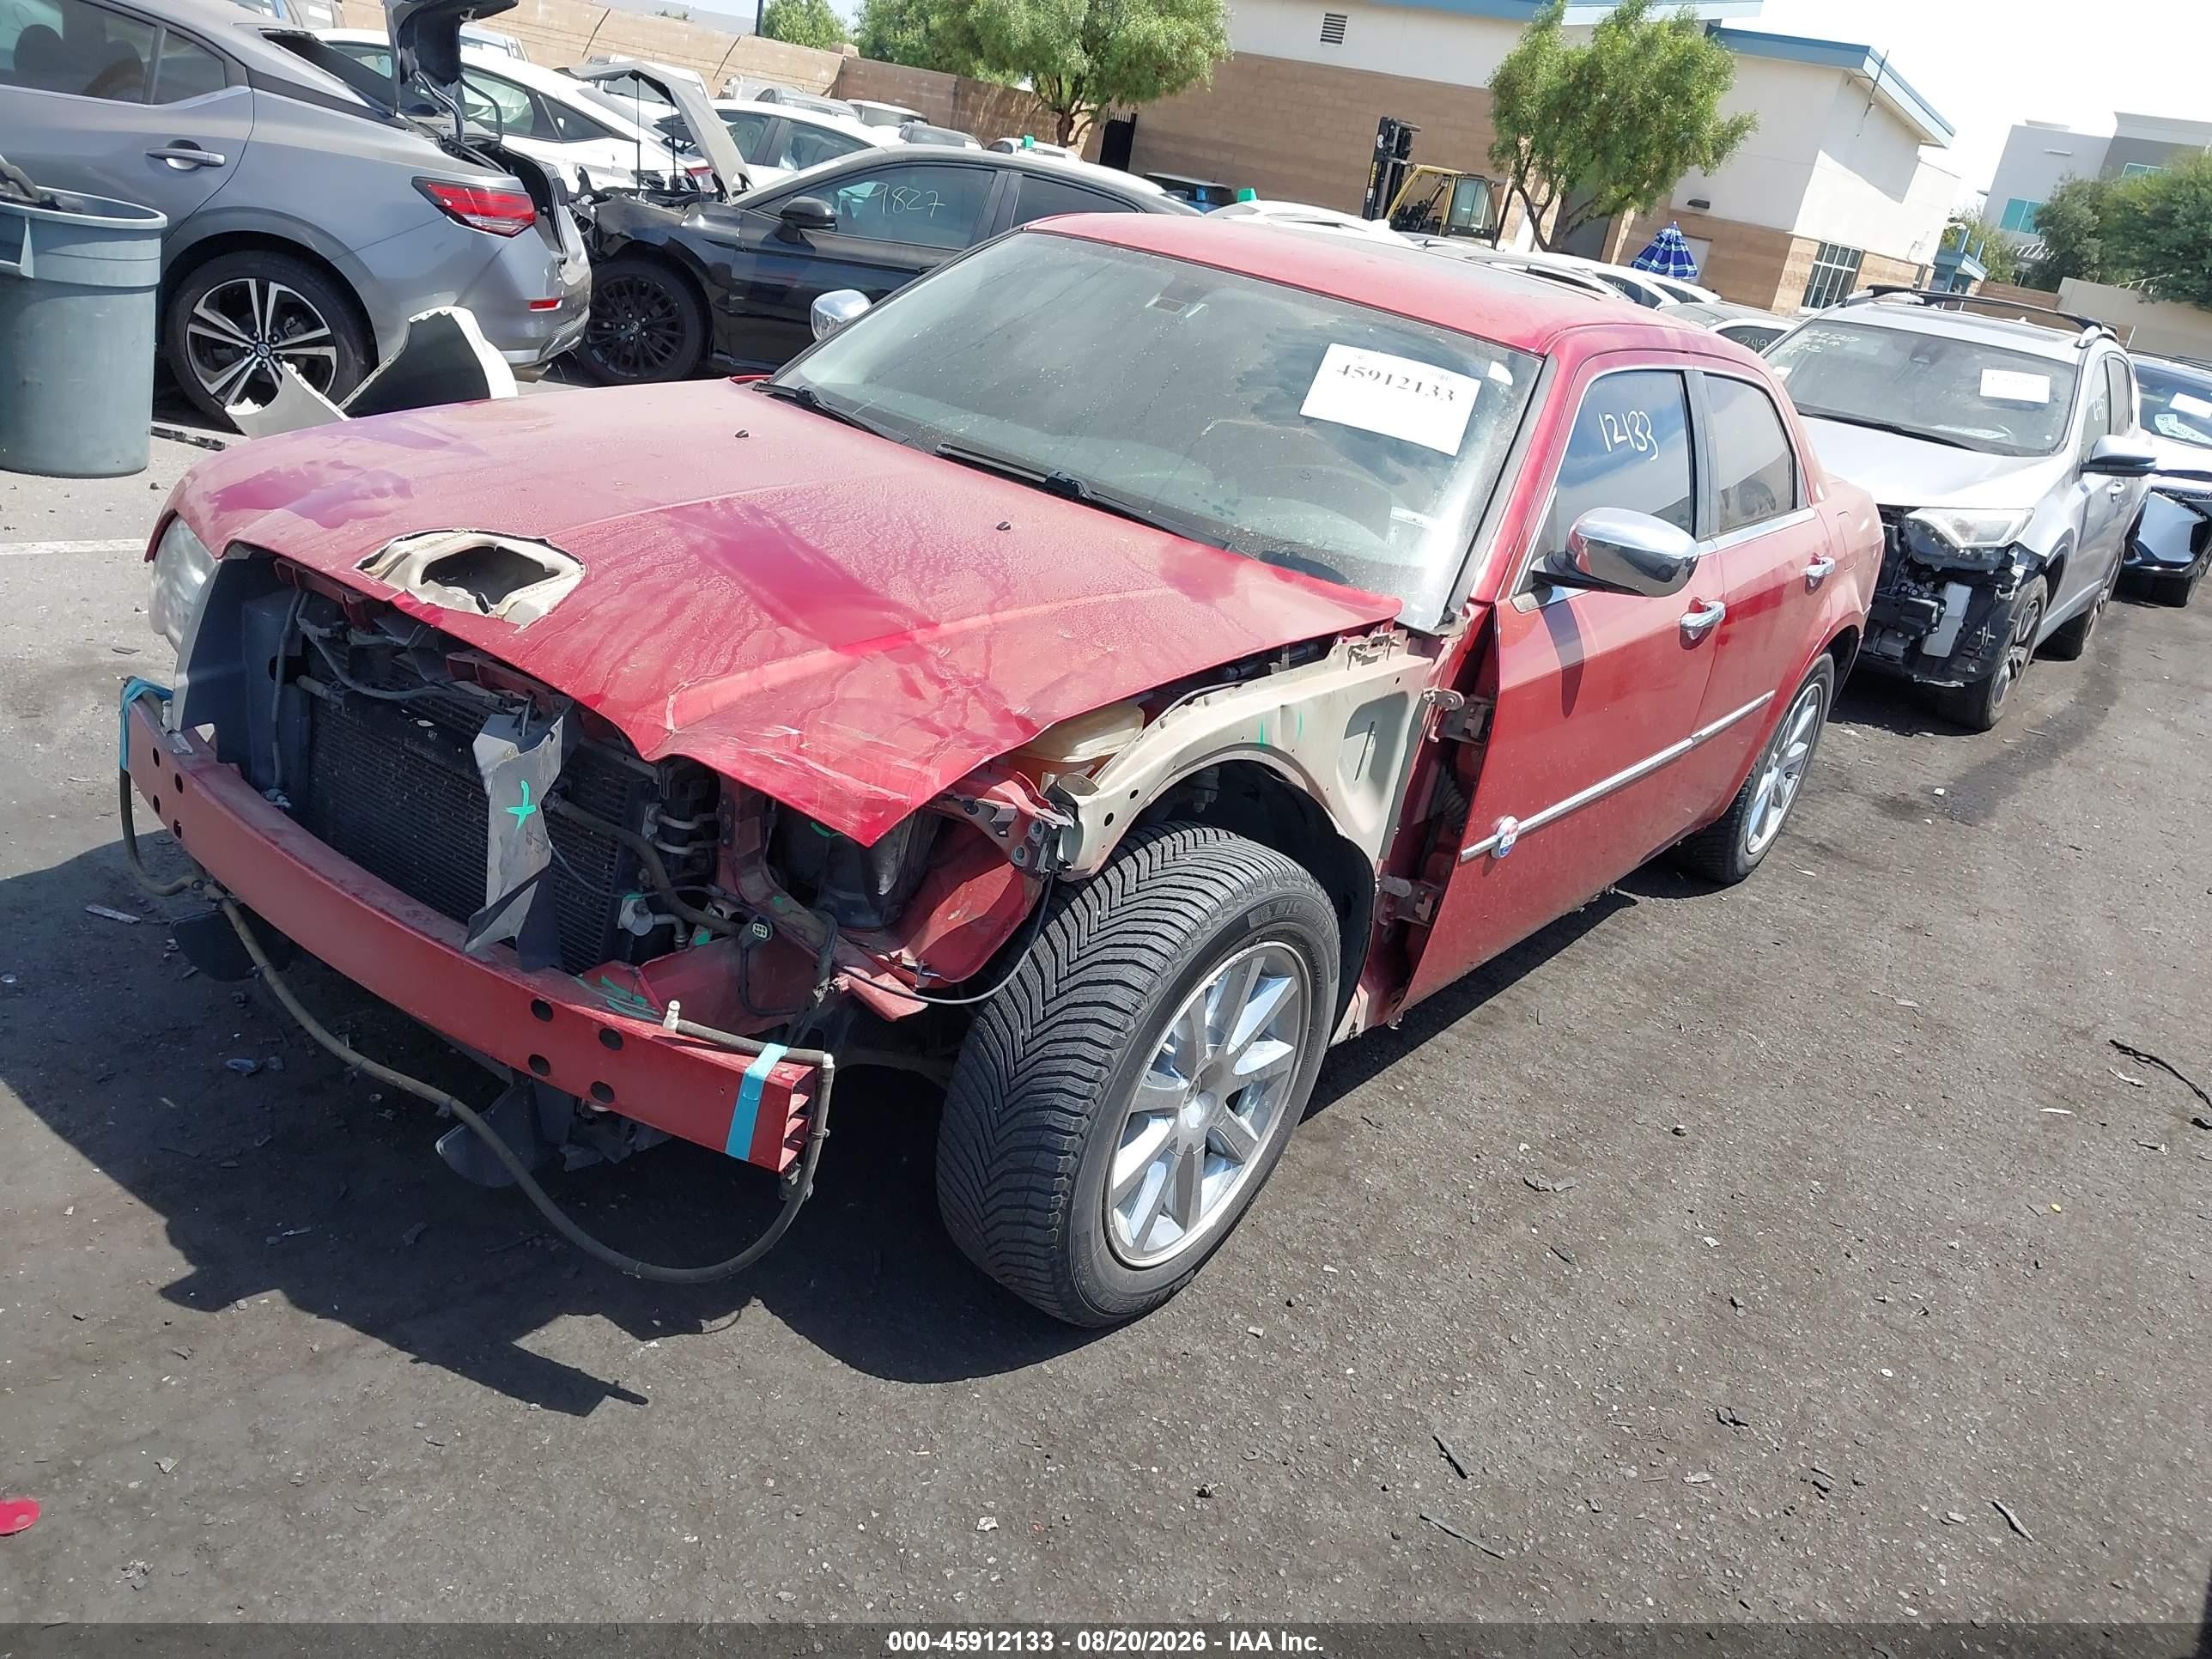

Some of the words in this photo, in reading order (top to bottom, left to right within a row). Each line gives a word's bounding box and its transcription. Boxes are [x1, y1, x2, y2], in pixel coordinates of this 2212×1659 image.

[870, 181, 946, 220] 9827
[1336, 364, 1455, 402] 45912133
[1598, 410, 1659, 461] 12133
